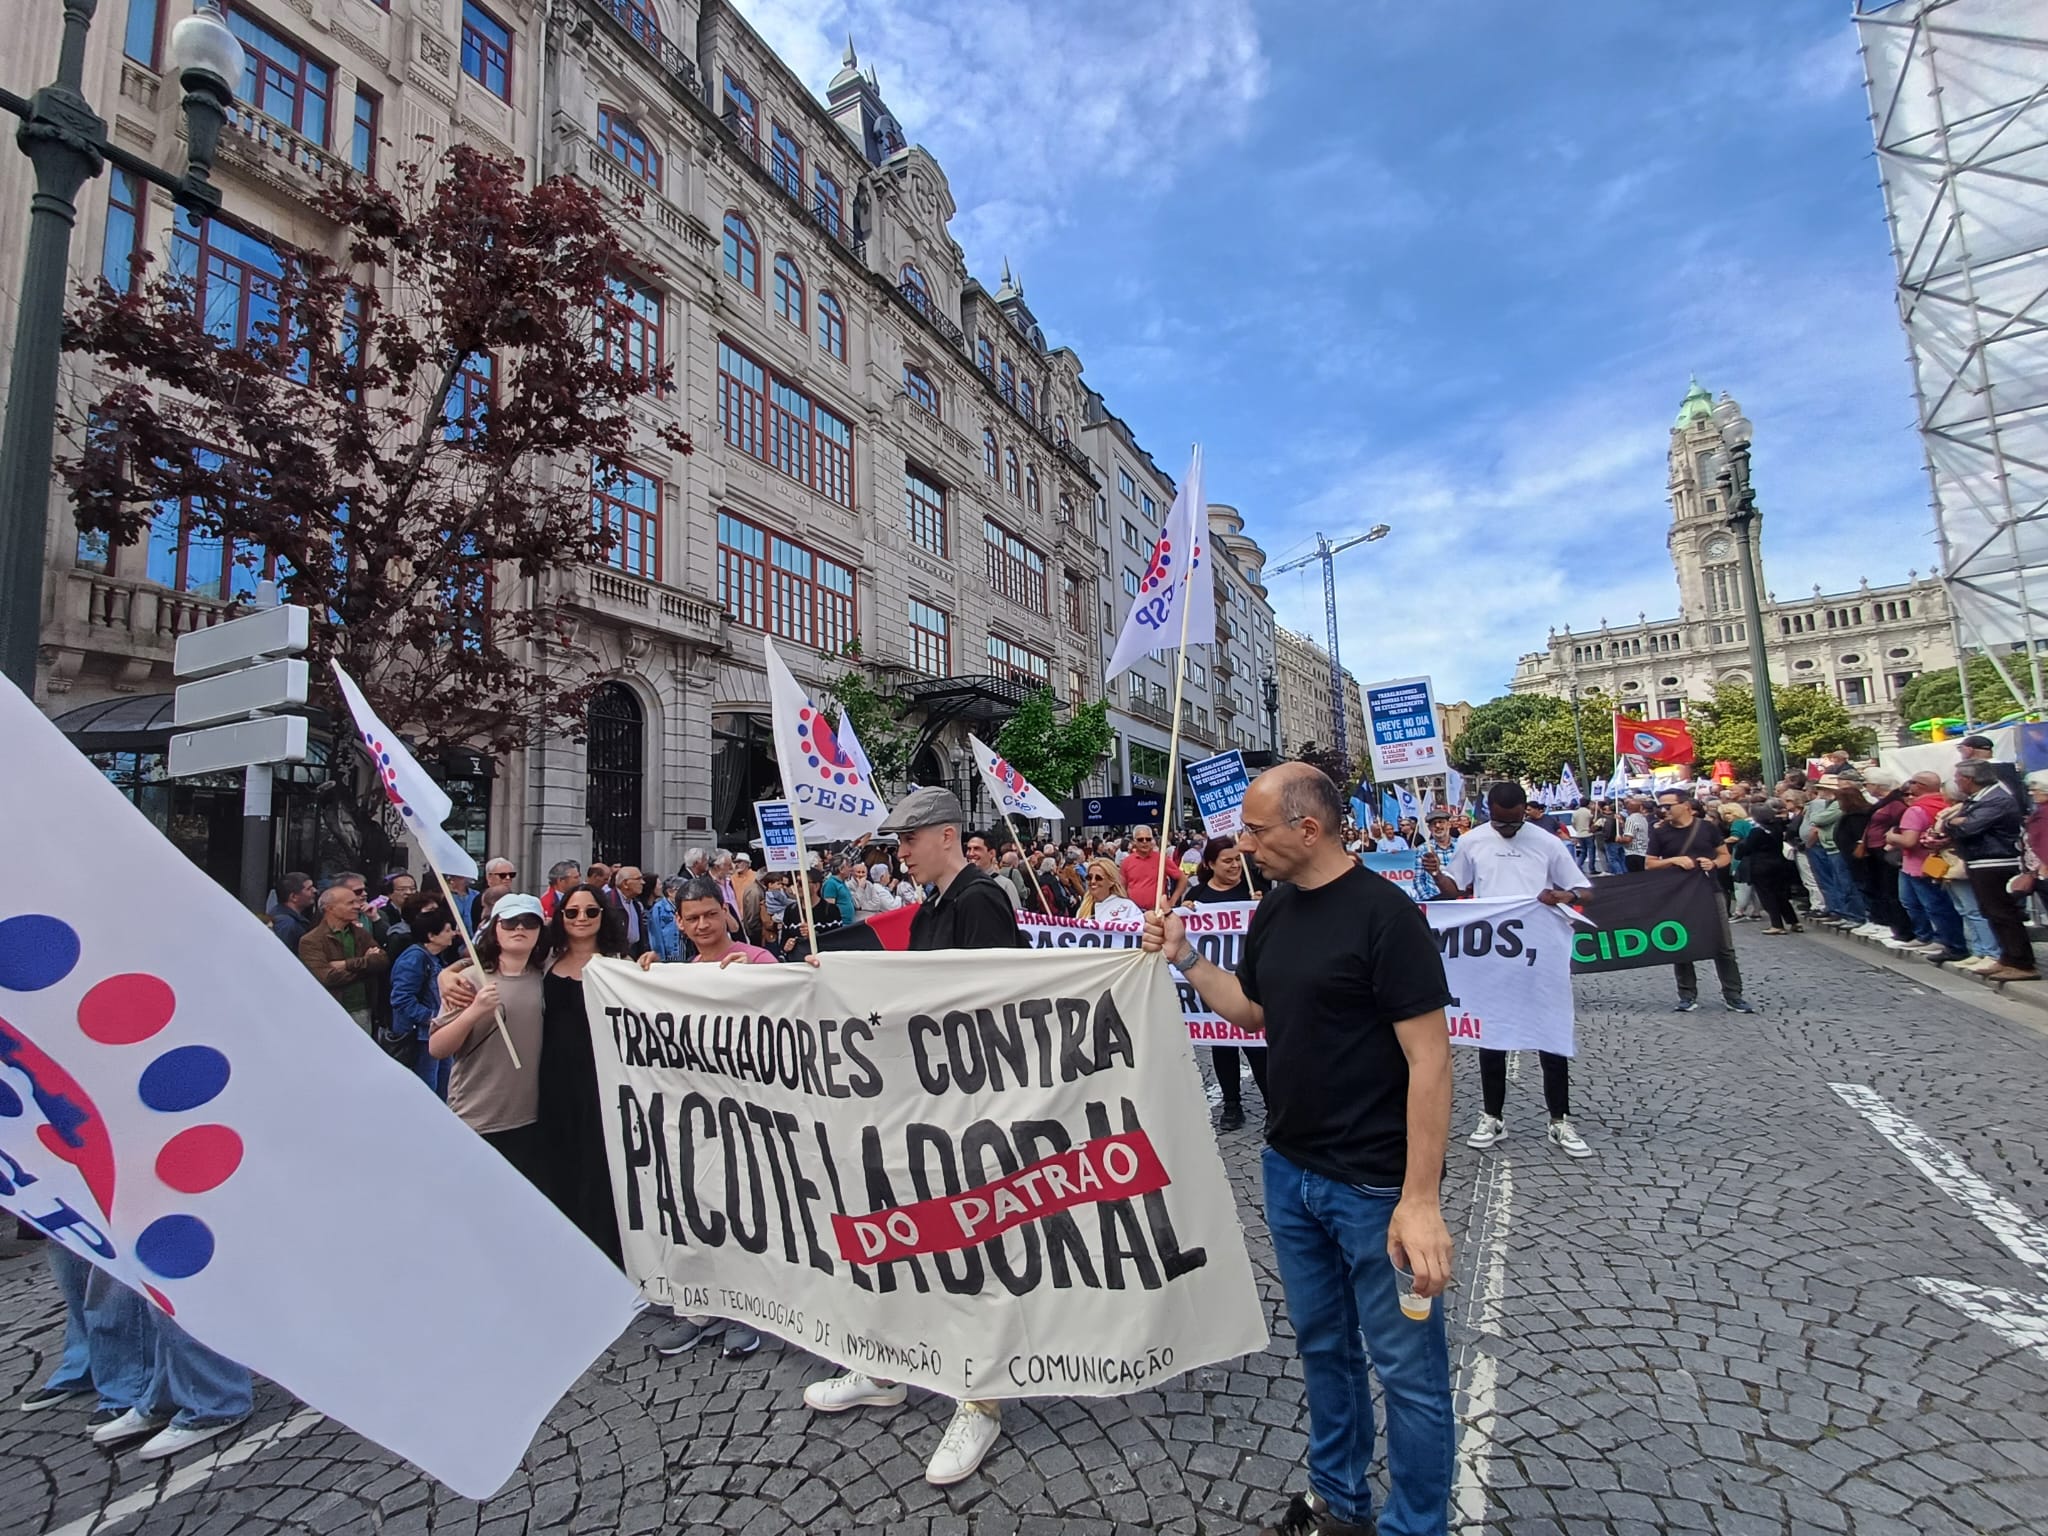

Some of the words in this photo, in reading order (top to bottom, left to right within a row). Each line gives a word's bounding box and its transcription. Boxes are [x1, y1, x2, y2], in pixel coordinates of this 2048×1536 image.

[1376, 720, 1402, 732] GREVE
[1403, 718, 1415, 729] NO
[1415, 715, 1430, 726] DIA
[1383, 732, 1392, 741] 10
[1394, 731, 1404, 740] DE
[1405, 727, 1426, 738] MAIO
[795, 784, 874, 817] CESP
[1200, 790, 1223, 804] GREVE
[1223, 786, 1234, 797] NO
[1234, 781, 1247, 793] DIA
[1208, 802, 1217, 812] 10
[1217, 799, 1228, 809] DE
[1217, 910, 1242, 930] DE
[1572, 920, 1689, 963] CIDO
[908, 988, 1134, 1096] CONTRA
[618, 1084, 834, 1277] PACOTE
[853, 1210, 920, 1258] DO
[951, 1141, 1138, 1238] PATRÃO
[684, 1287, 709, 1306] DAS
[719, 1288, 804, 1334] TECNOLOGIAS
[815, 1319, 831, 1346] DE
[840, 1332, 942, 1377] INFORMAÇÃO
[964, 1358, 973, 1388] E
[1008, 1347, 1174, 1387] COMUNICAÇÃO
